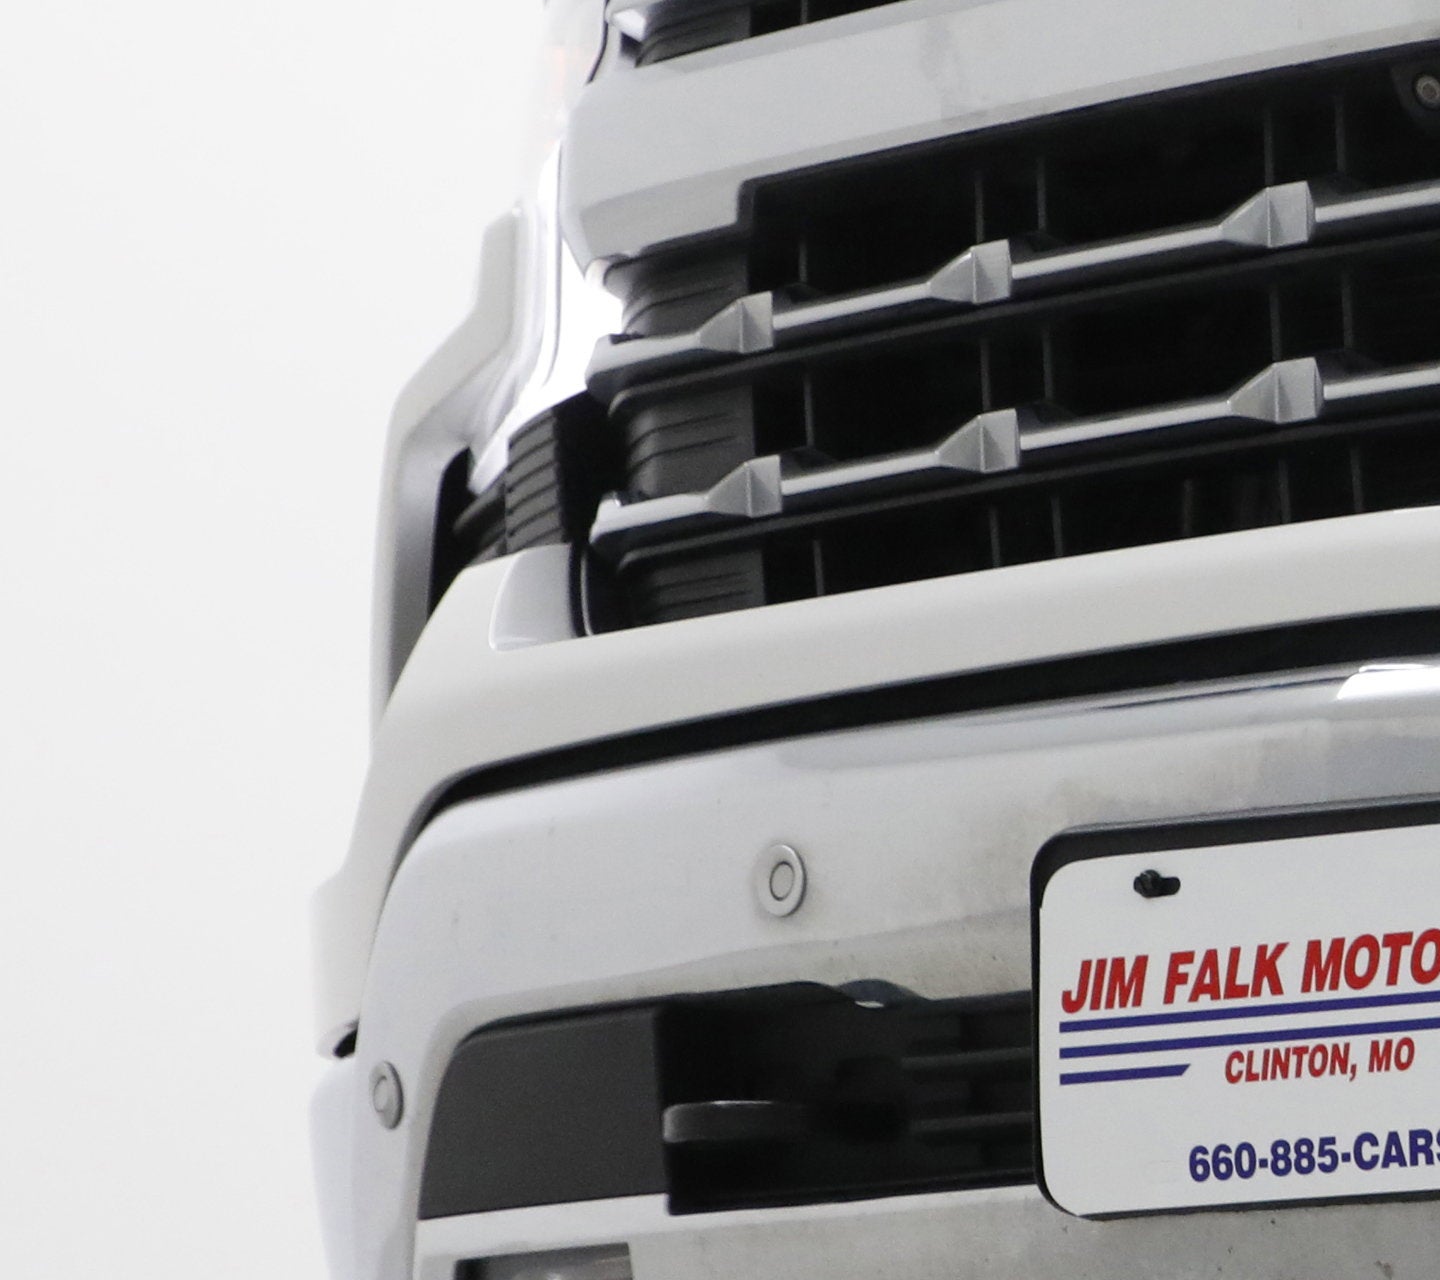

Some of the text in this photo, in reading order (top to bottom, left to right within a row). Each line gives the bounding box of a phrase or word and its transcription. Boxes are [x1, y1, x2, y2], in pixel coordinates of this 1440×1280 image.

[1061, 954, 1149, 1015] JIM
[1163, 942, 1288, 1005] FALK
[1225, 1037, 1416, 1084] CLINTON, MO
